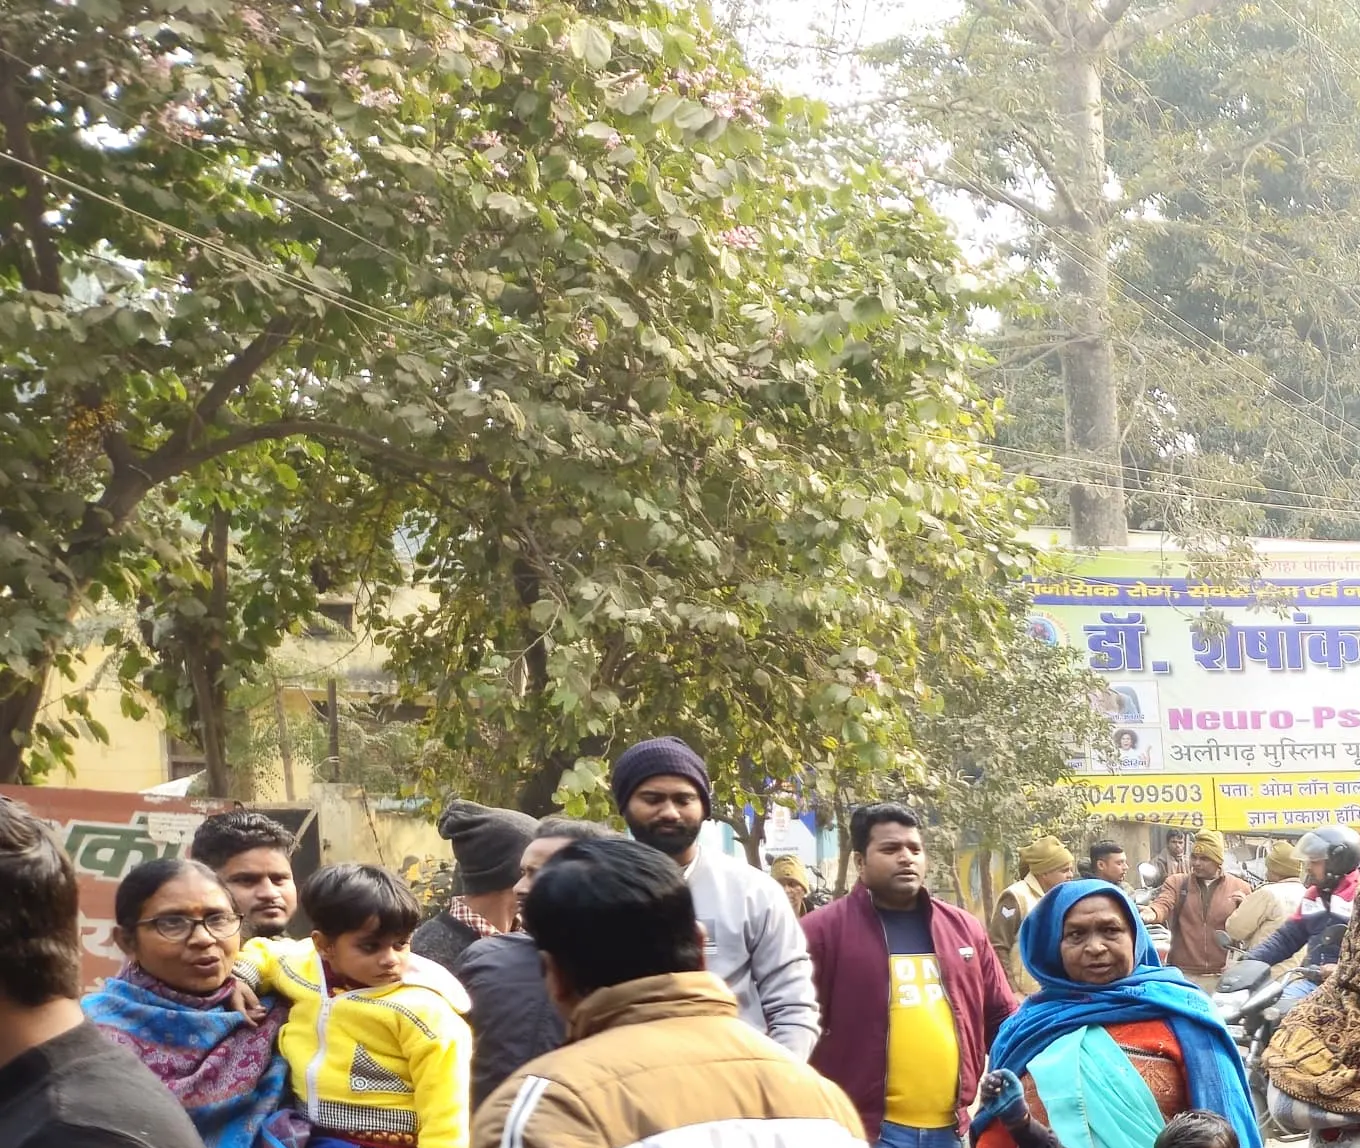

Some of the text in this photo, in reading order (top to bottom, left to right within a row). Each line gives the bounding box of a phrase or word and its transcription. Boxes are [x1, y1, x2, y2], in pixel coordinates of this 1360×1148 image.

[1170, 736, 1256, 767] अलीगढ़
[1259, 736, 1337, 768] मुस्लिम
[1260, 777, 1293, 798] ओम
[1297, 778, 1330, 796] लॉन
[1283, 809, 1331, 826] प्रकाश
